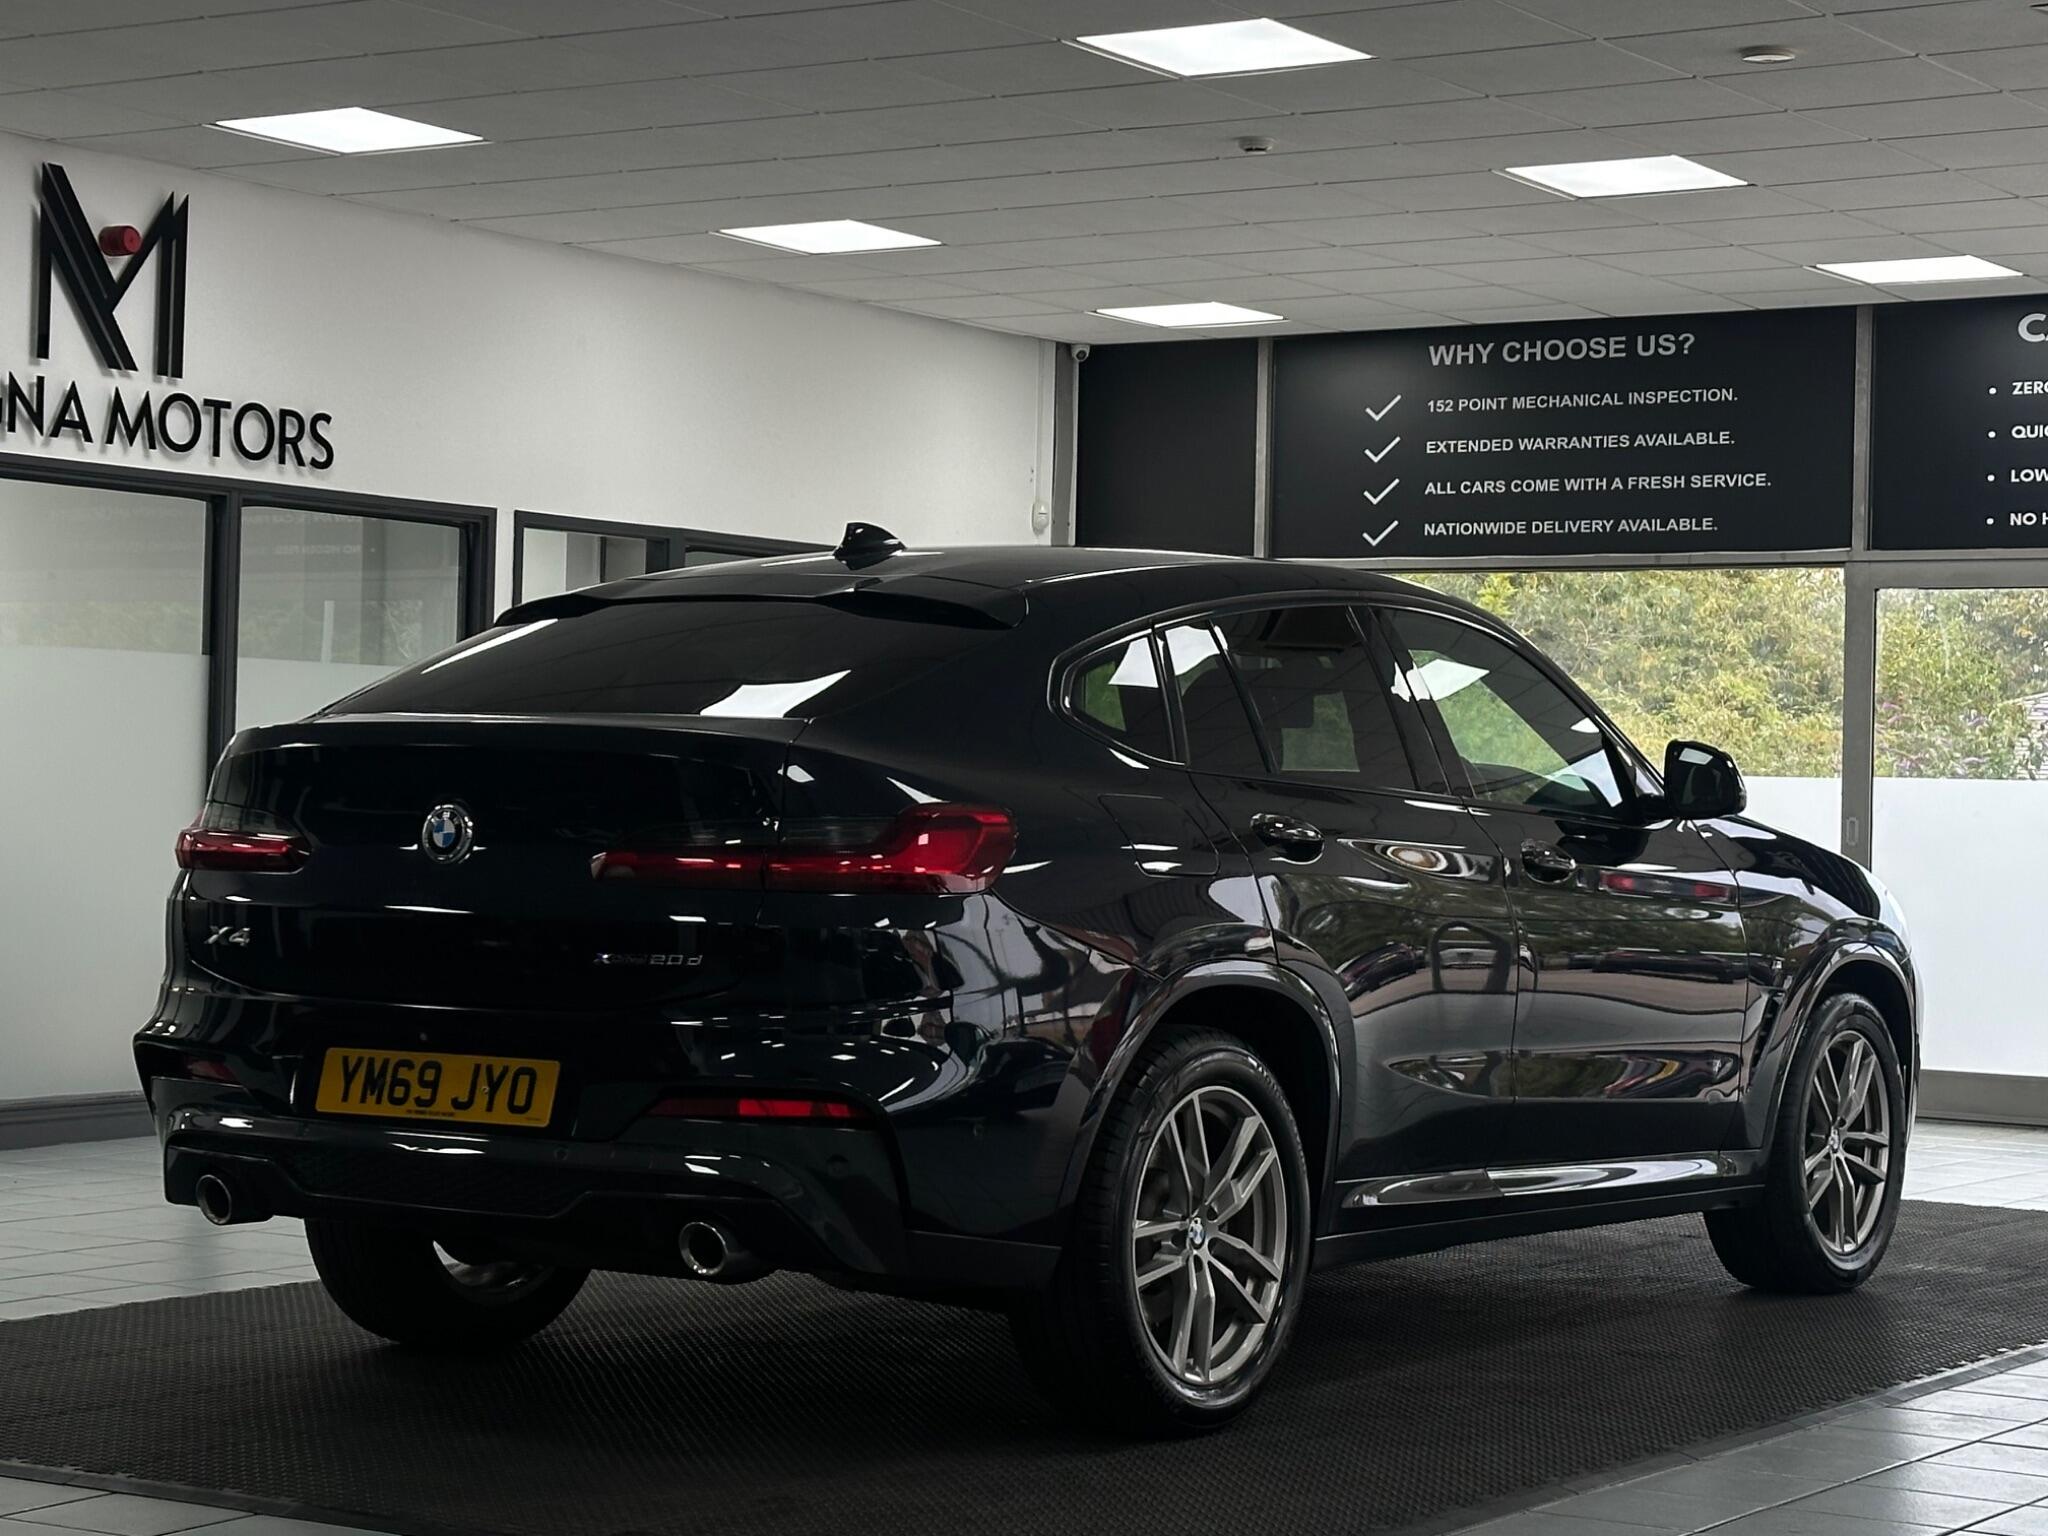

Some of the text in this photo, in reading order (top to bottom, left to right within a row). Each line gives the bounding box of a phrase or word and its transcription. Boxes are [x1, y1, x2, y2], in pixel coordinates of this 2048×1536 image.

[2018, 313, 2048, 342] C
[1429, 332, 1696, 366] WHY CHOOSE US?
[1428, 388, 1738, 412] 152 POINT MECHANICAL INSPECTION.
[0, 370, 335, 470] NA MOTORS
[1426, 431, 1735, 453] EXTENDED WARRANTIES AVAILABLE.
[1425, 473, 1771, 495] ALL CARS COME WITH A FRESH SERVICE.
[1424, 517, 1718, 536] NATIONWIDE DELIVERY AVAILABLE.
[2010, 512, 2037, 526] NO
[203, 925, 251, 947] X4
[340, 1055, 537, 1115] YM69 JYO
